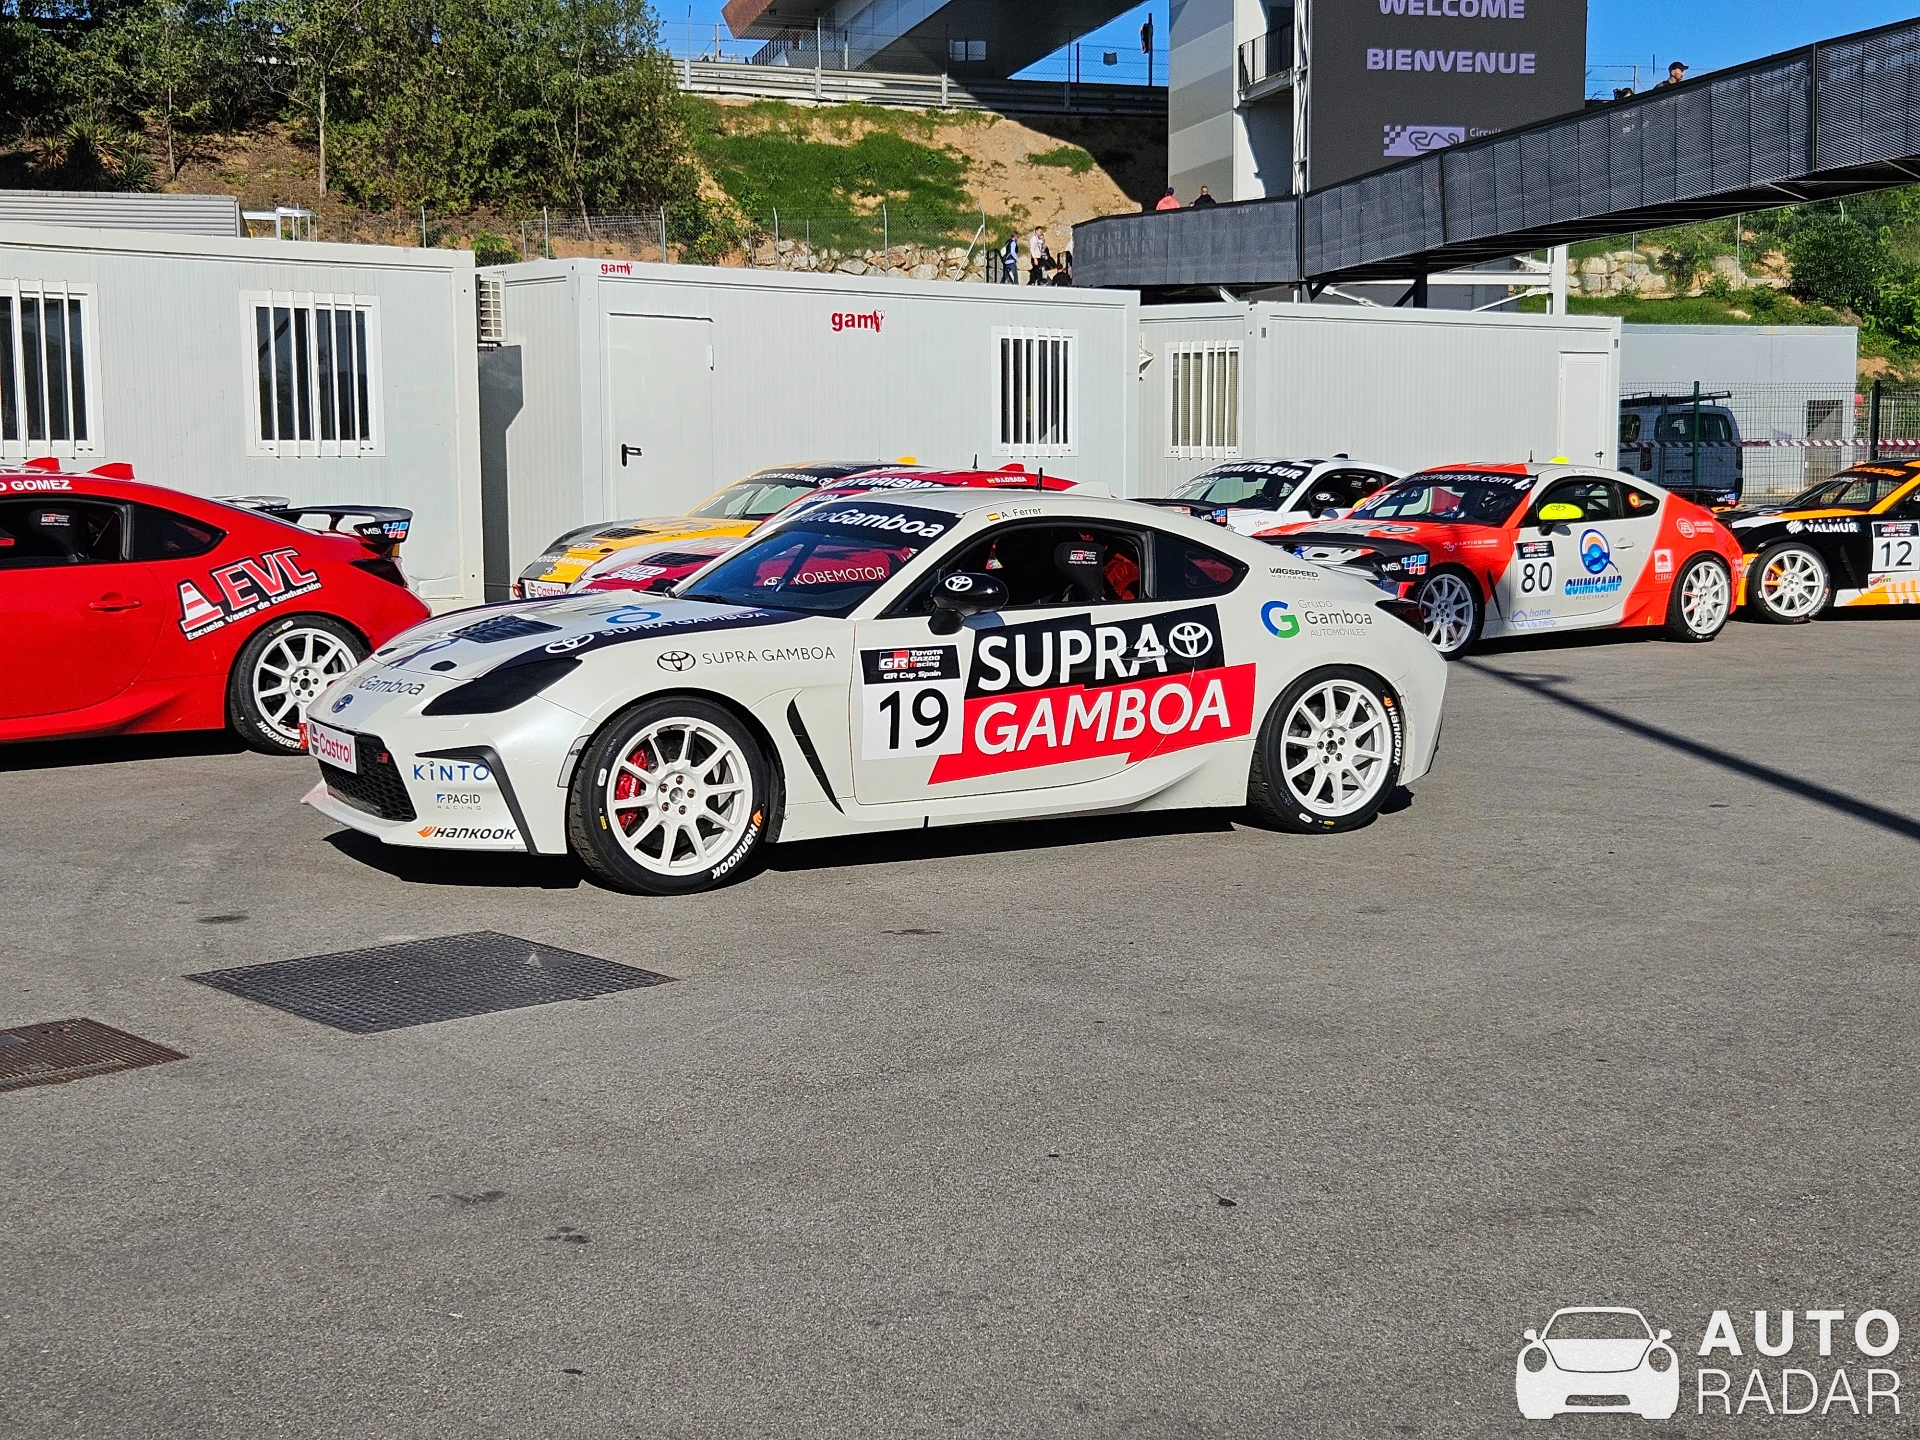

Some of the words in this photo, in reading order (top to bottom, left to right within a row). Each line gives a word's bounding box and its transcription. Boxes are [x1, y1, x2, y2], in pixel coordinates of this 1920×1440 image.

[1379, 0, 1525, 19] WELCOME
[1366, 49, 1536, 74] BIENVENUE
[1267, 466, 1304, 479] SUR
[10, 480, 73, 491] GOMEZ
[1013, 508, 1042, 517] Ferrer
[1805, 523, 1858, 532] VALMUR
[1881, 541, 1912, 567] 12
[794, 567, 886, 586] KOBEMOTOR
[1269, 567, 1318, 578] VAGSPEED
[1521, 562, 1552, 593] 80
[1564, 575, 1622, 596] QUIMICAMP
[1298, 599, 1332, 609] Grupo
[1529, 608, 1551, 617] home
[186, 620, 224, 641] Escuela
[226, 606, 256, 623] Vasca
[257, 601, 270, 610] de
[1304, 609, 1373, 625] Gamboa
[702, 650, 757, 665] SUPRA
[761, 646, 836, 663] GAMBOA
[880, 657, 908, 669] GR
[977, 623, 1169, 691] SUPRA
[910, 661, 939, 669] Racing
[883, 672, 898, 680] GR
[900, 671, 916, 679] Cup
[918, 670, 941, 678] Spain
[879, 688, 949, 750] 19
[974, 679, 1231, 755] GAMBOA
[320, 733, 352, 765] Castrol
[447, 794, 481, 805] PAGID
